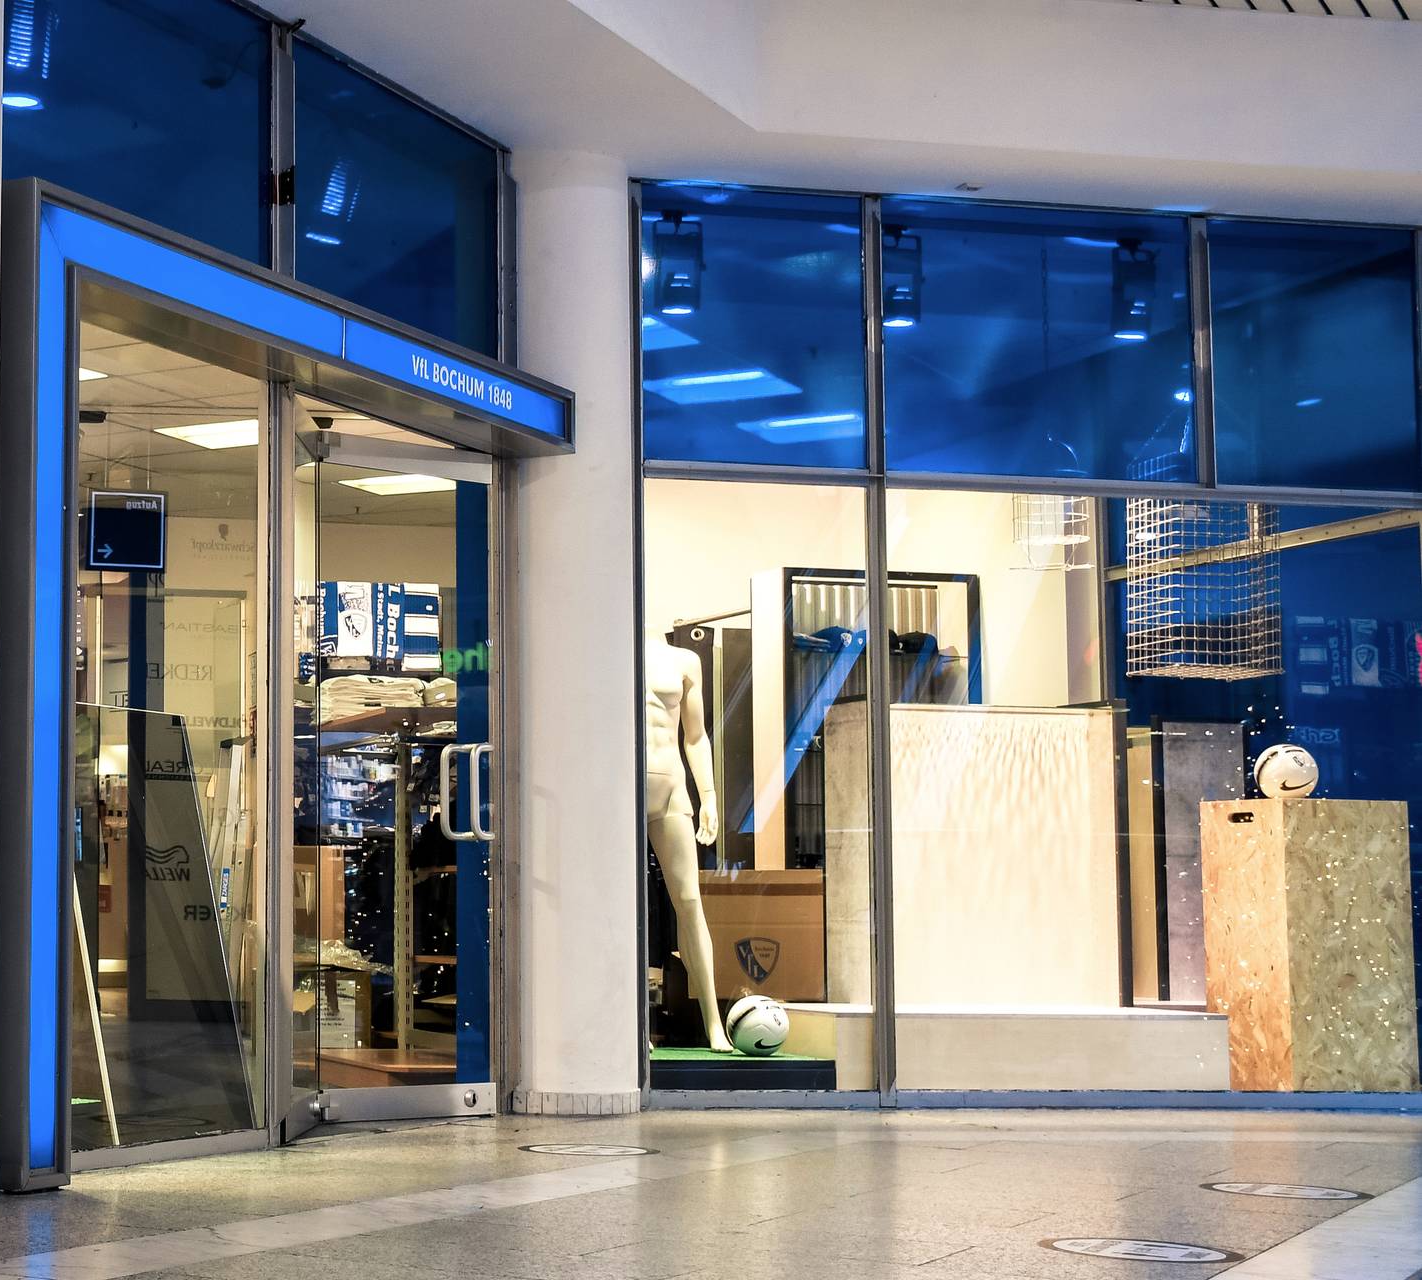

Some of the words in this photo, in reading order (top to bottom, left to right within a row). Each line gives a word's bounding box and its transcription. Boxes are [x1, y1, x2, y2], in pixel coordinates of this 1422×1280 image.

[412, 354, 429, 380] VfL
[433, 362, 485, 401] BOCHUM
[488, 383, 512, 410] 1848
